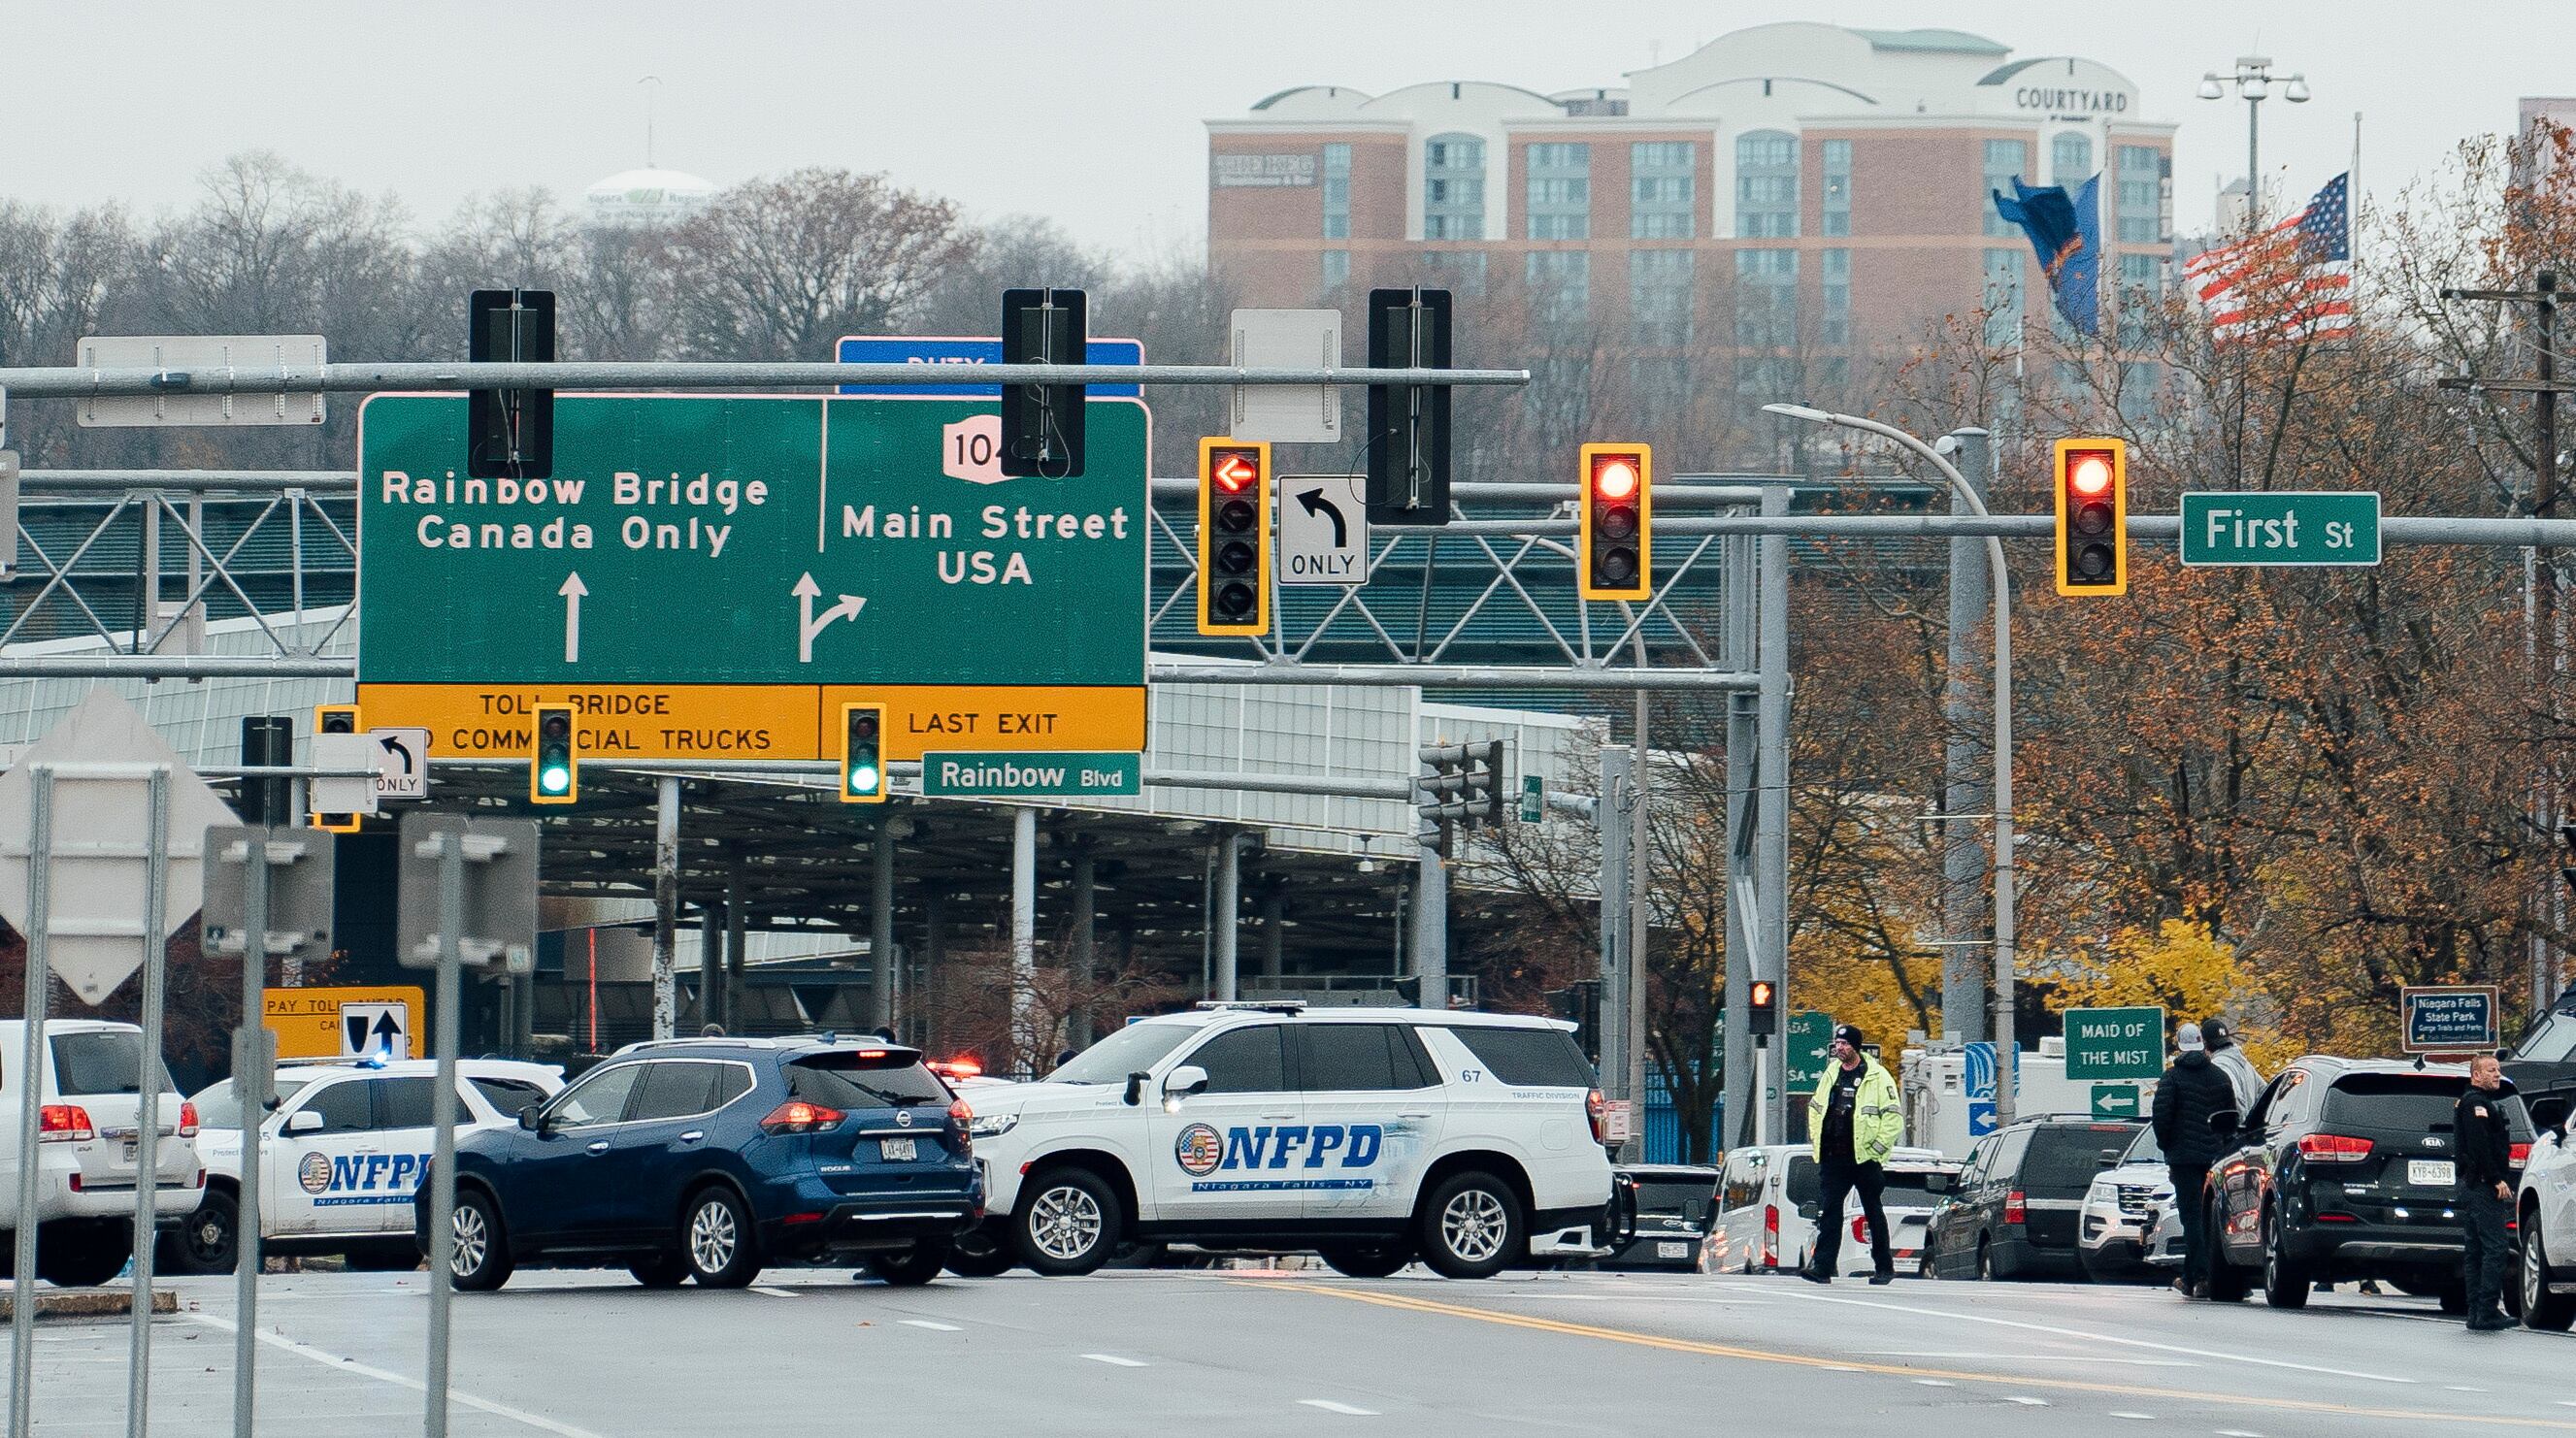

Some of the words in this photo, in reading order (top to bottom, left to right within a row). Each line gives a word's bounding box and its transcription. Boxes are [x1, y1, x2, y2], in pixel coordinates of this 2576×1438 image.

[2017, 87, 2128, 112] COURTYARD
[956, 434, 1003, 467] 10
[382, 471, 586, 505] Rainbow
[613, 472, 769, 515] Bridge
[842, 506, 953, 539] Main
[981, 506, 1129, 539] Street
[2206, 508, 2298, 549] First
[2326, 521, 2355, 549] St
[416, 514, 594, 550] Canada
[621, 516, 732, 559] Only
[938, 551, 1034, 585] USA
[1292, 554, 1355, 575] ONLY
[568, 694, 670, 714] BRIDGE
[908, 713, 978, 734] LAST
[998, 713, 1058, 734] EXIT
[452, 729, 641, 750] COMMCIAL
[661, 729, 772, 750] TRUCKS
[376, 779, 418, 792] ONLY
[941, 762, 1066, 788] Rainbow
[1080, 769, 1123, 788] Blvd
[267, 999, 298, 1012] PAY
[2418, 998, 2457, 1011] Niagara
[2459, 997, 2482, 1008] Falls
[2425, 1012, 2451, 1023] State
[2452, 1012, 2476, 1022] Park
[2081, 1024, 2121, 1038] MAID
[2125, 1024, 2146, 1037] OF
[2080, 1051, 2110, 1065] THE
[2114, 1051, 2149, 1065] MIST
[1462, 1070, 1481, 1083] 67
[1788, 1070, 1807, 1082] SA
[1221, 1125, 1383, 1170] NFPD
[1197, 1182, 1271, 1192] Niagara
[1344, 1180, 1370, 1189] NY
